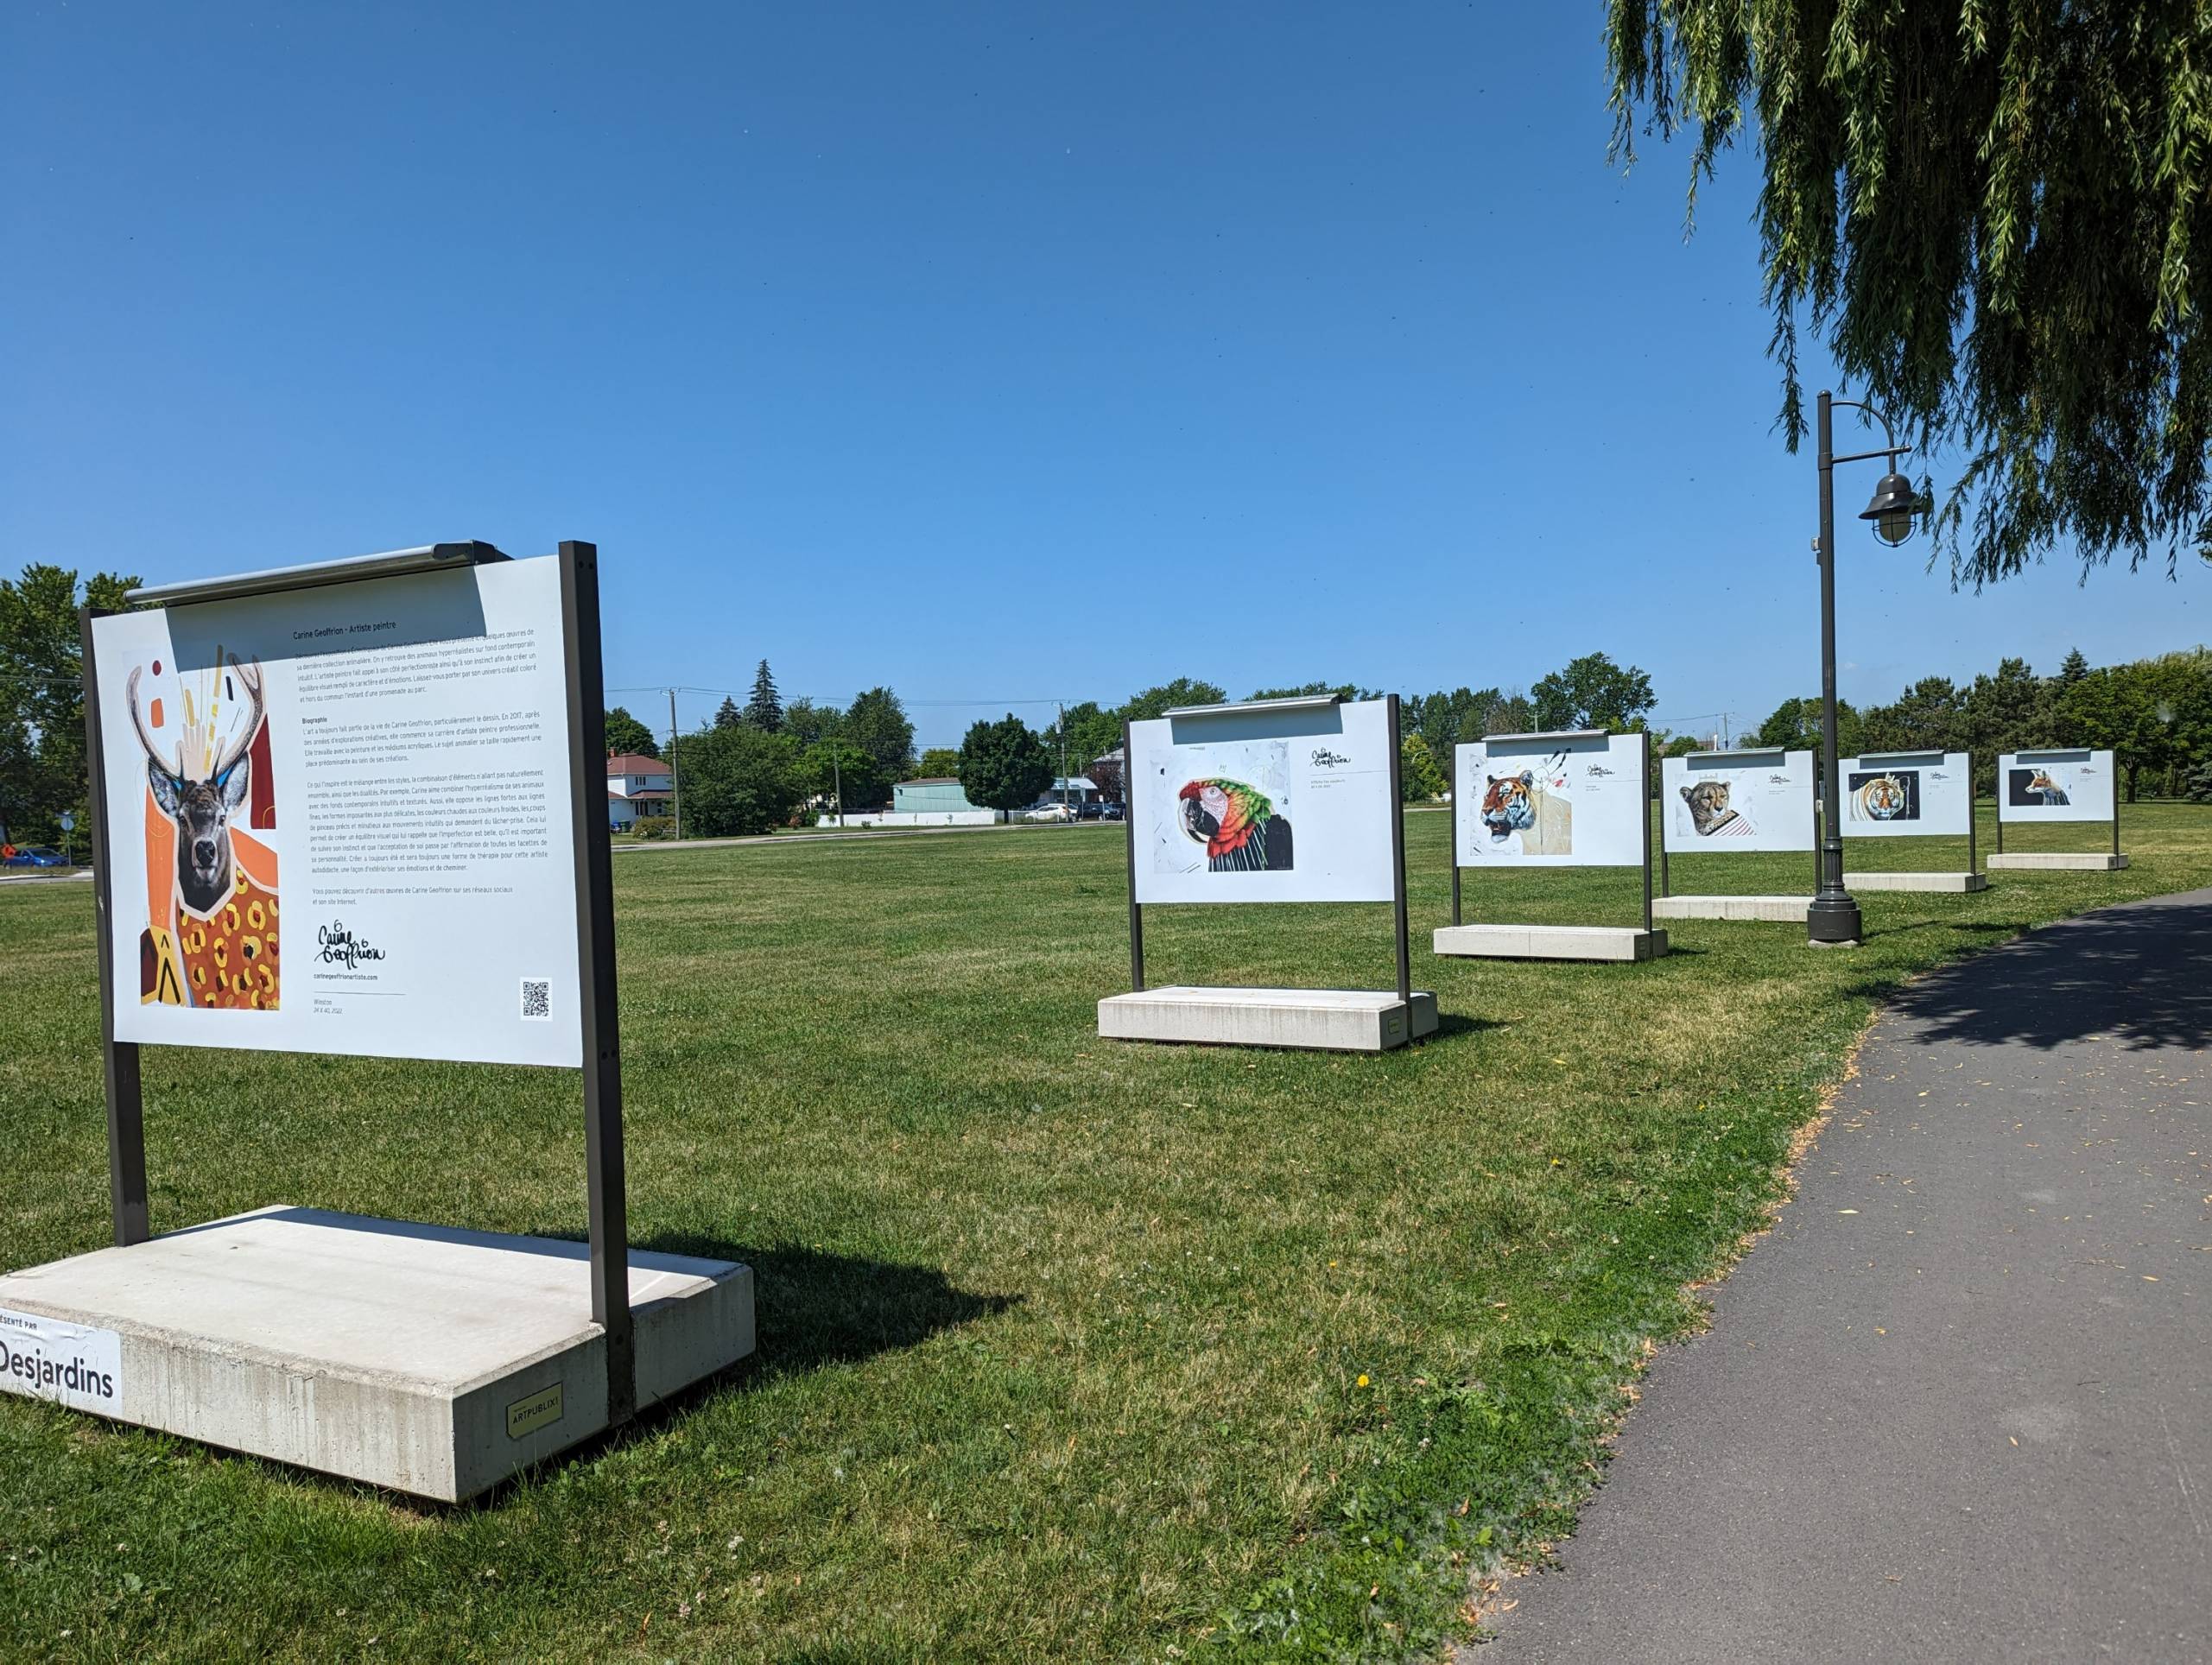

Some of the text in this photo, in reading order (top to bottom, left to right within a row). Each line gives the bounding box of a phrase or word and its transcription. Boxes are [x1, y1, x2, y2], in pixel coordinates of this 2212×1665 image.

[293, 630, 313, 640] Carine
[349, 623, 371, 634] Artiste
[372, 621, 396, 632] peintre
[513, 652, 528, 661] créer
[461, 671, 471, 680] par
[509, 711, 523, 720] 2017,
[524, 710, 540, 720] après
[520, 827, 547, 837] important
[318, 919, 356, 946] Carine
[24, 1320, 38, 1331] PAR
[512, 1396, 560, 1424] ARTPUBLIX!
